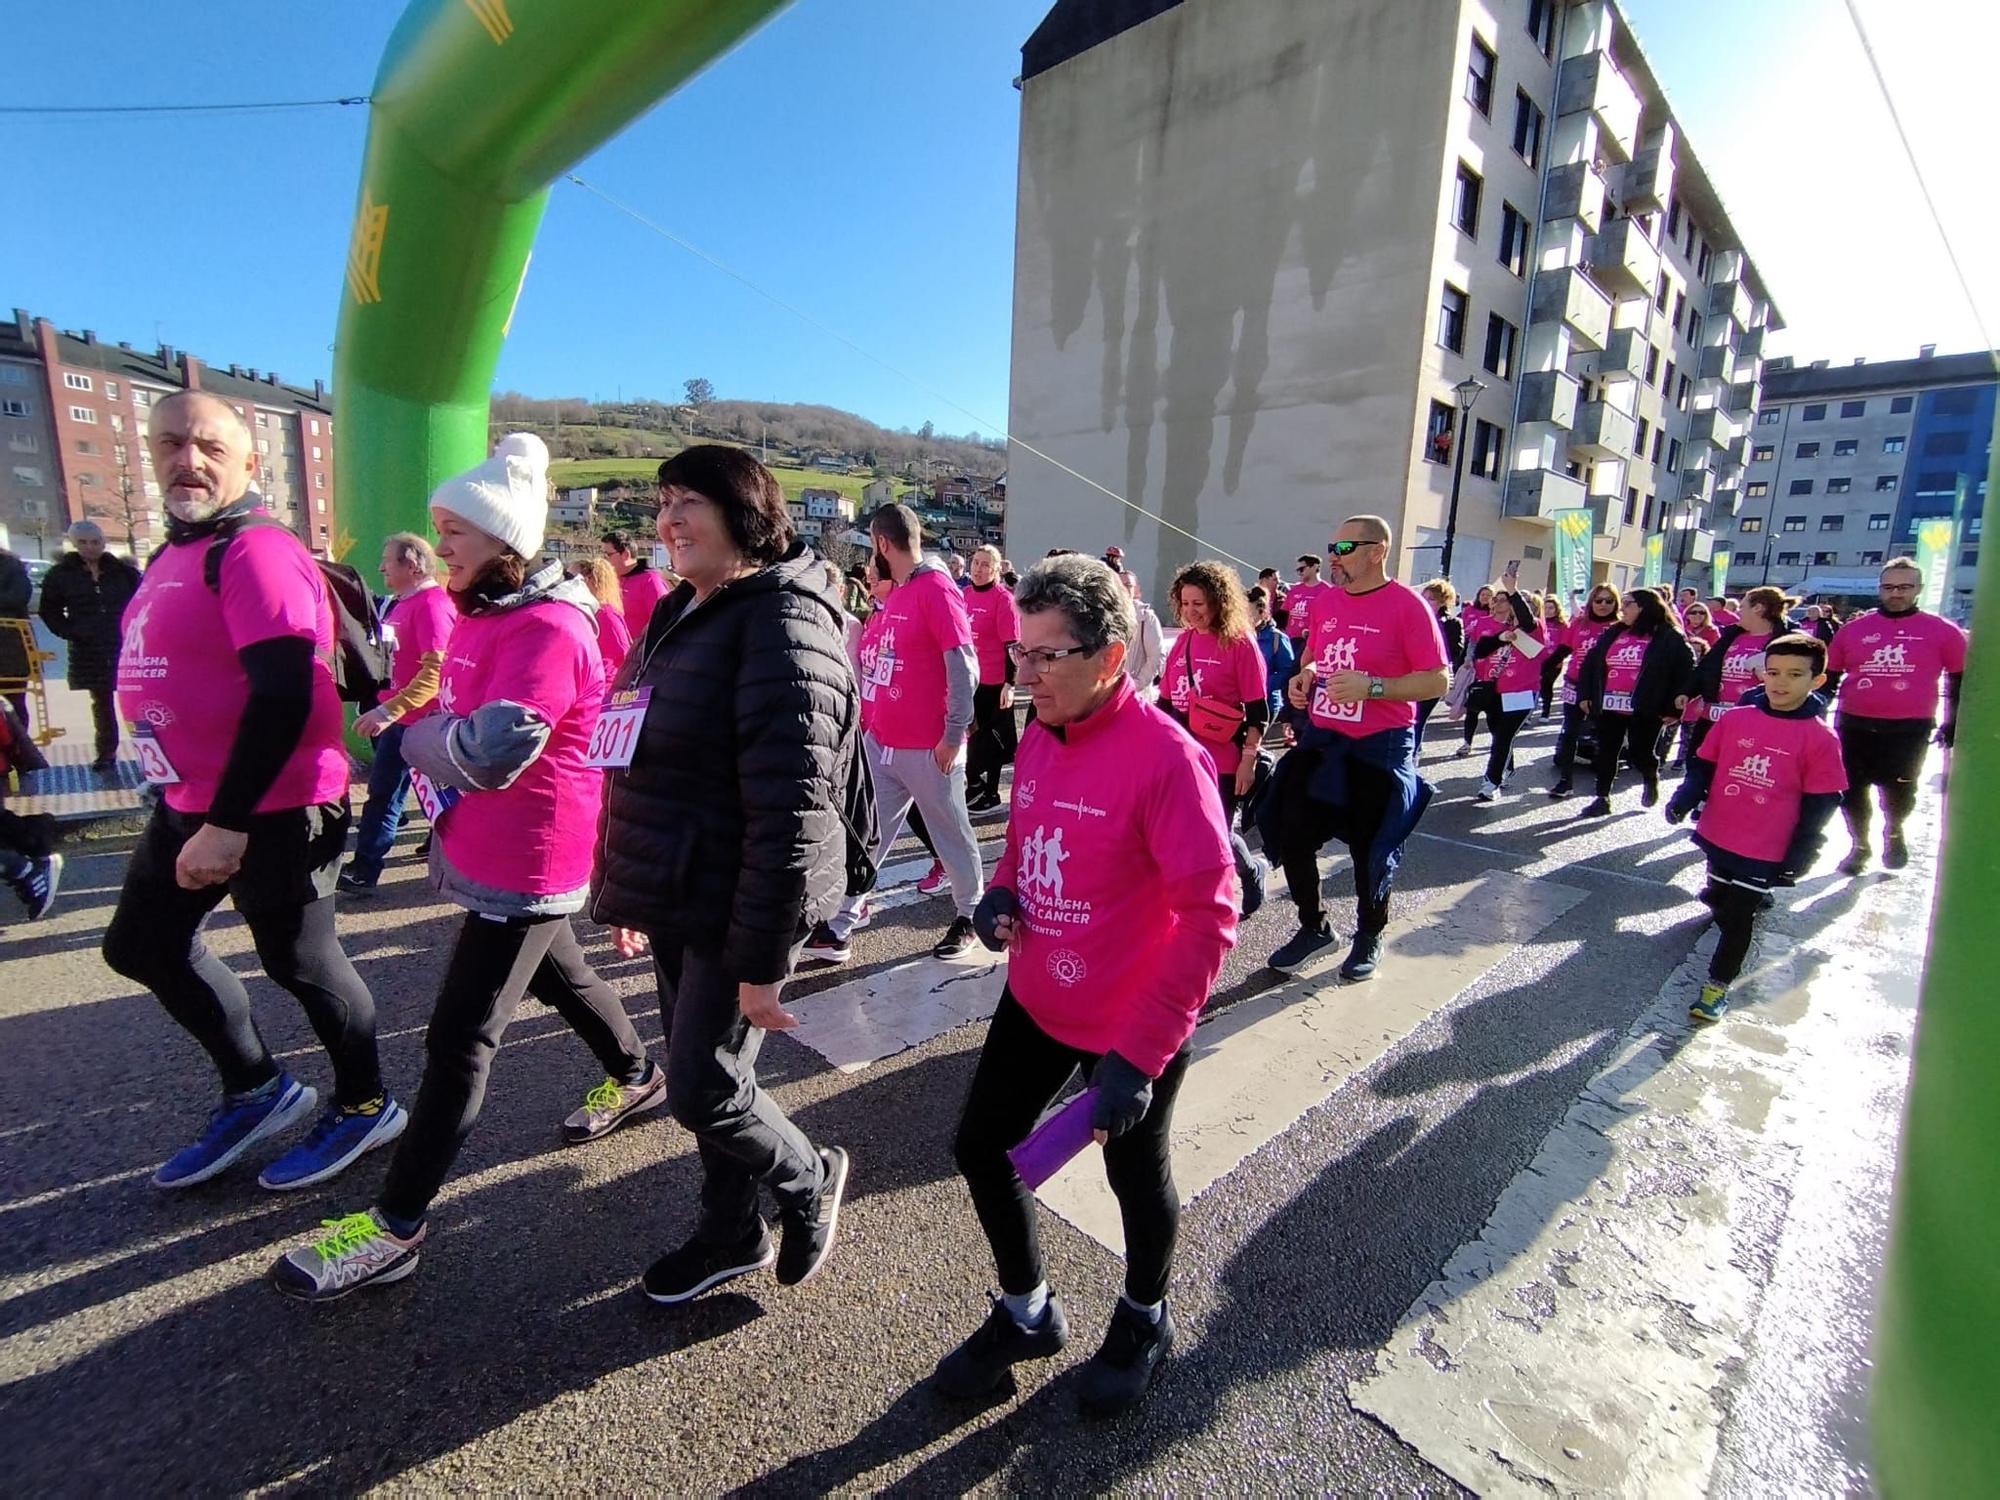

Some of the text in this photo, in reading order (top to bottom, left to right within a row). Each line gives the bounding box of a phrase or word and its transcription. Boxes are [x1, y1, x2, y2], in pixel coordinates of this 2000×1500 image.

[589, 715, 636, 760] 301
[1037, 907, 1091, 925] CÁNCER
[1031, 924, 1063, 937] CENTRO
